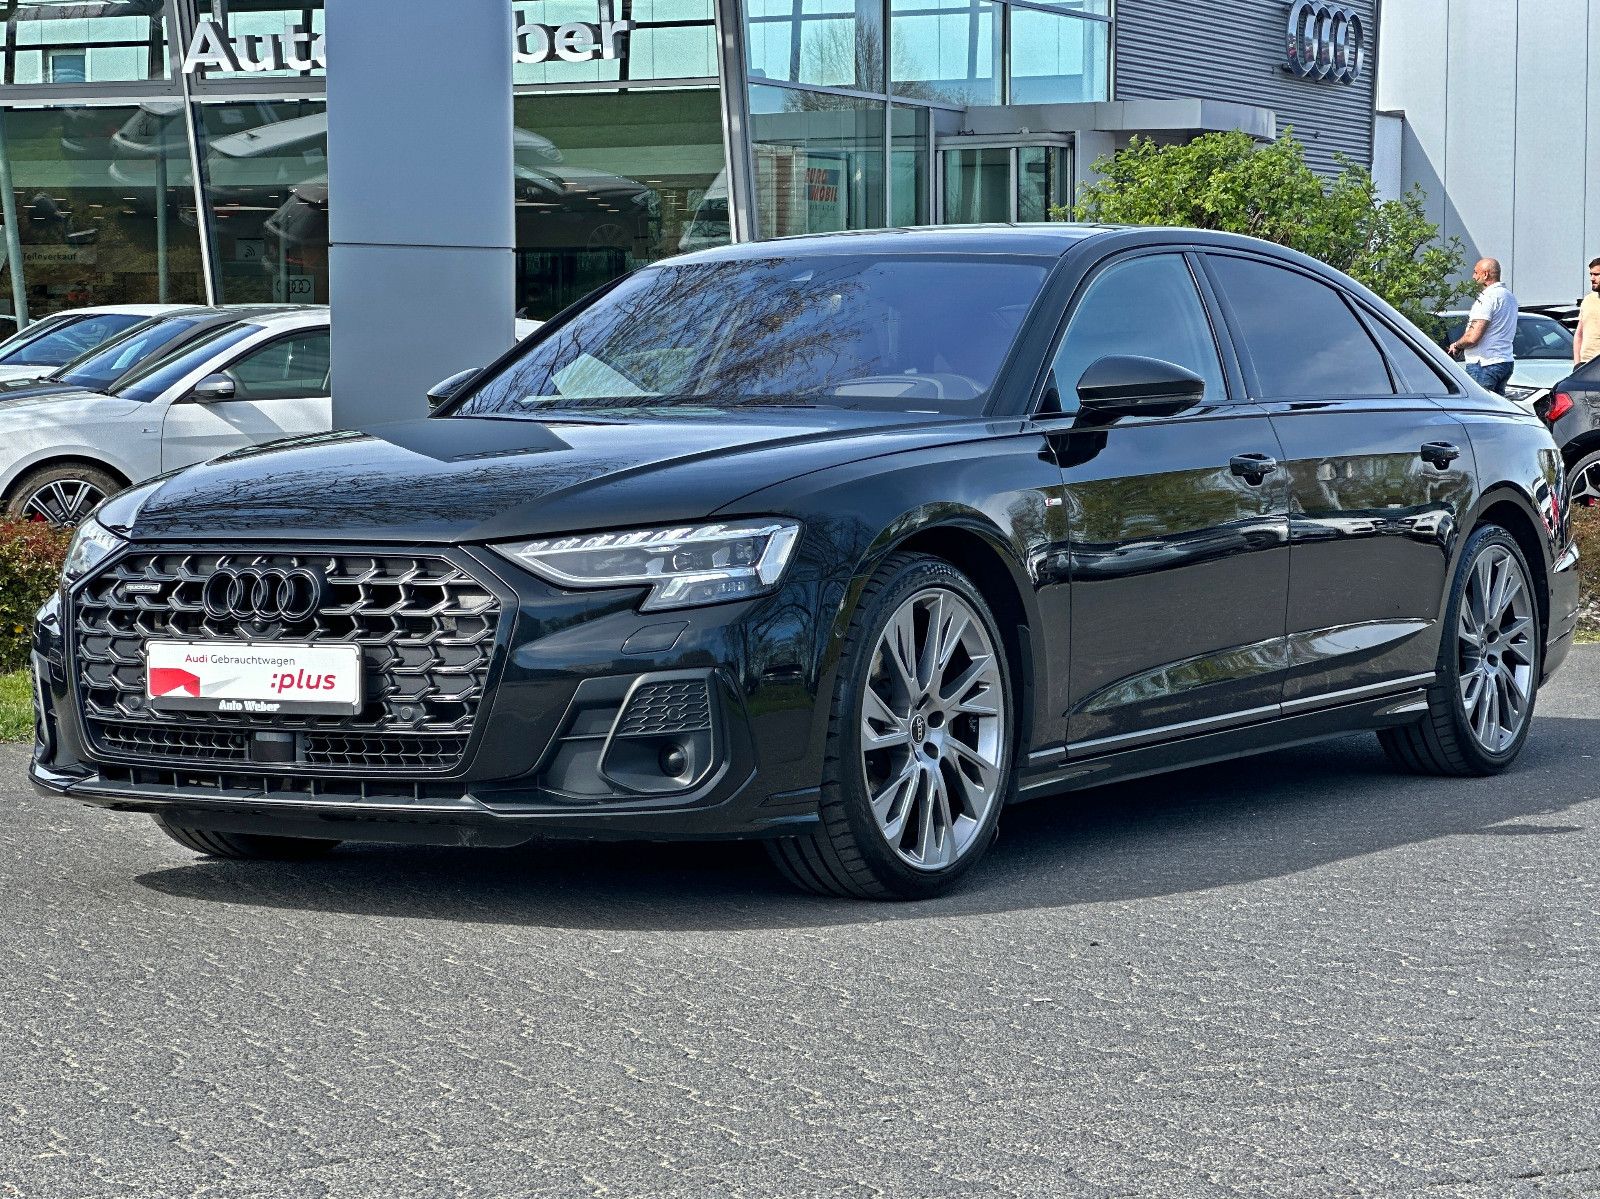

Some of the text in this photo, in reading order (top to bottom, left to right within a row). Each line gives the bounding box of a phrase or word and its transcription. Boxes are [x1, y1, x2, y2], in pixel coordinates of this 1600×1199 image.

[185, 654, 296, 666] Audi Gebrauchtwagen
[218, 699, 281, 712] Auto Weber
